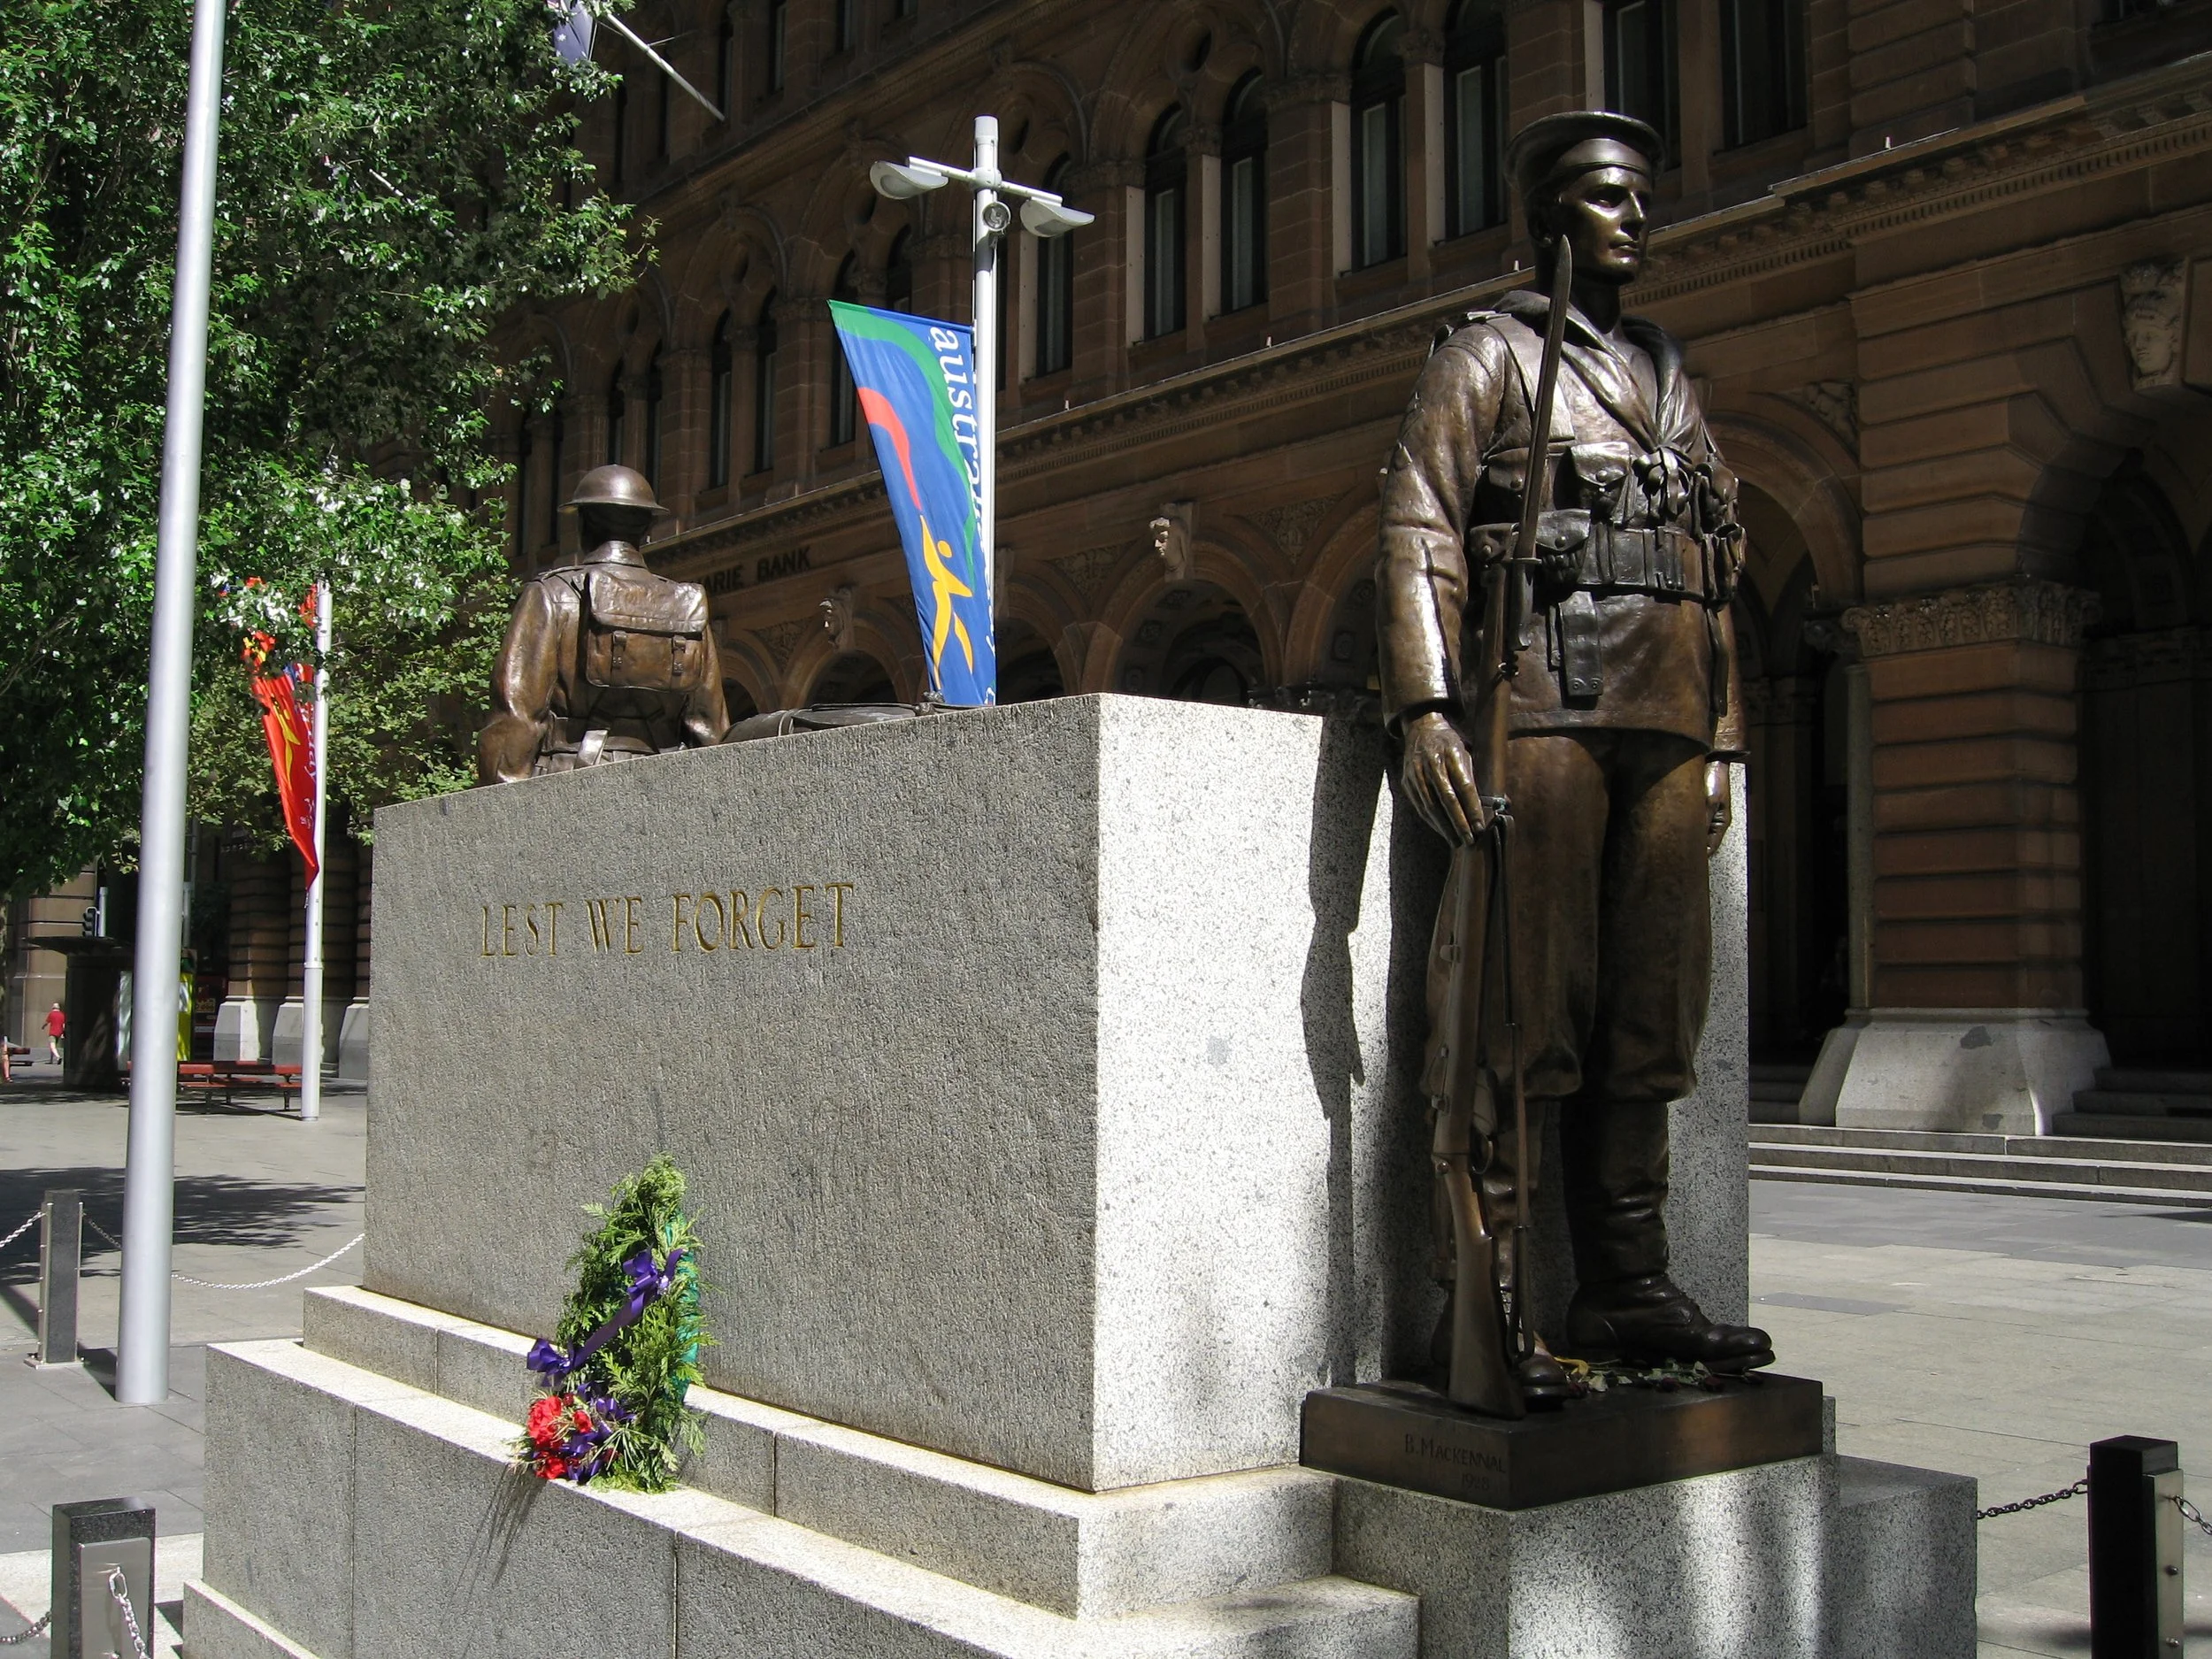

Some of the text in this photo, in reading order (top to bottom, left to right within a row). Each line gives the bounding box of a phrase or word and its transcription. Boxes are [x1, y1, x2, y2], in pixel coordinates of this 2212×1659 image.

[703, 546, 810, 595] ARIE BANK
[480, 882, 855, 957] LEST WE FORGET
